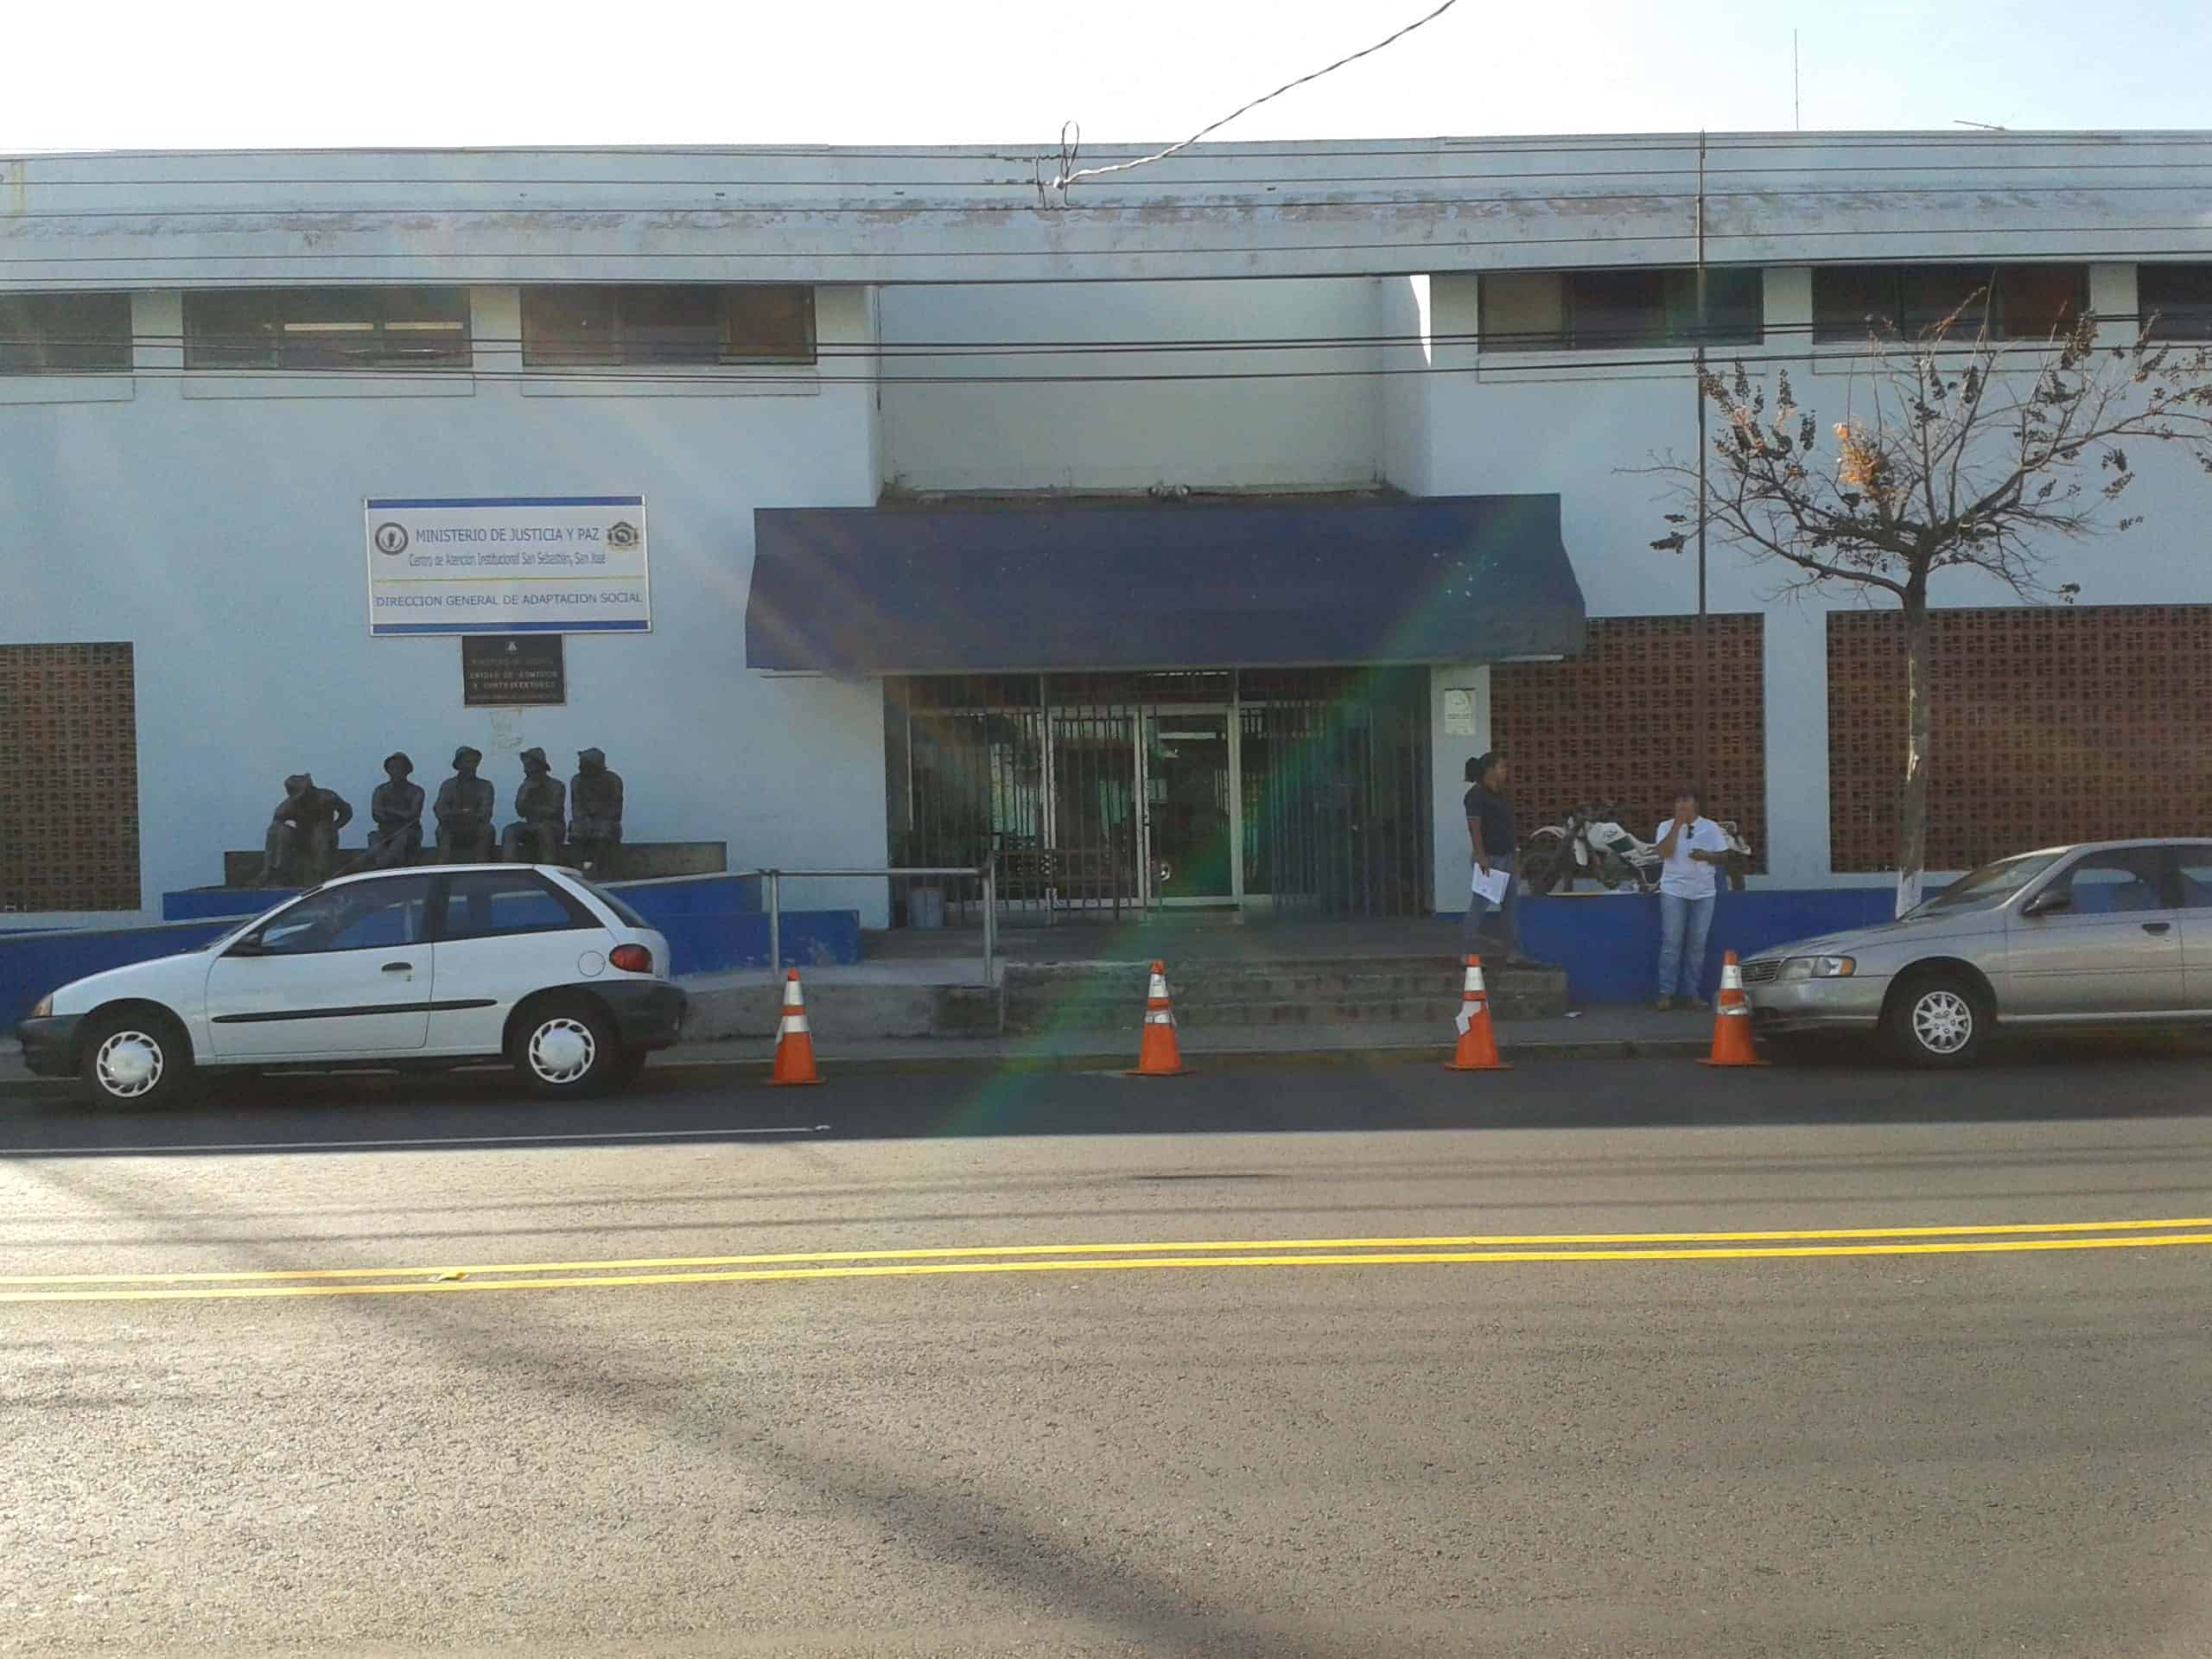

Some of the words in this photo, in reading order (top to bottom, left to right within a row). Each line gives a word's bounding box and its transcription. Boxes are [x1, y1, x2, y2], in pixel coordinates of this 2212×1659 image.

[416, 528, 487, 543] MINISTERIO
[491, 528, 506, 541] DE
[511, 527, 563, 541] JUSTICIA
[566, 527, 574, 540] Y
[578, 527, 601, 540] PAZ
[409, 553, 433, 567] Centro
[435, 553, 444, 566] de
[477, 552, 520, 566] Institucional
[522, 552, 537, 565] San
[575, 551, 590, 564] San
[375, 594, 443, 607] DIRECCION
[446, 594, 499, 606] GENERAL
[503, 594, 519, 605] DE
[523, 593, 597, 605] ADAPTACION
[601, 592, 645, 604] SOCIAL
